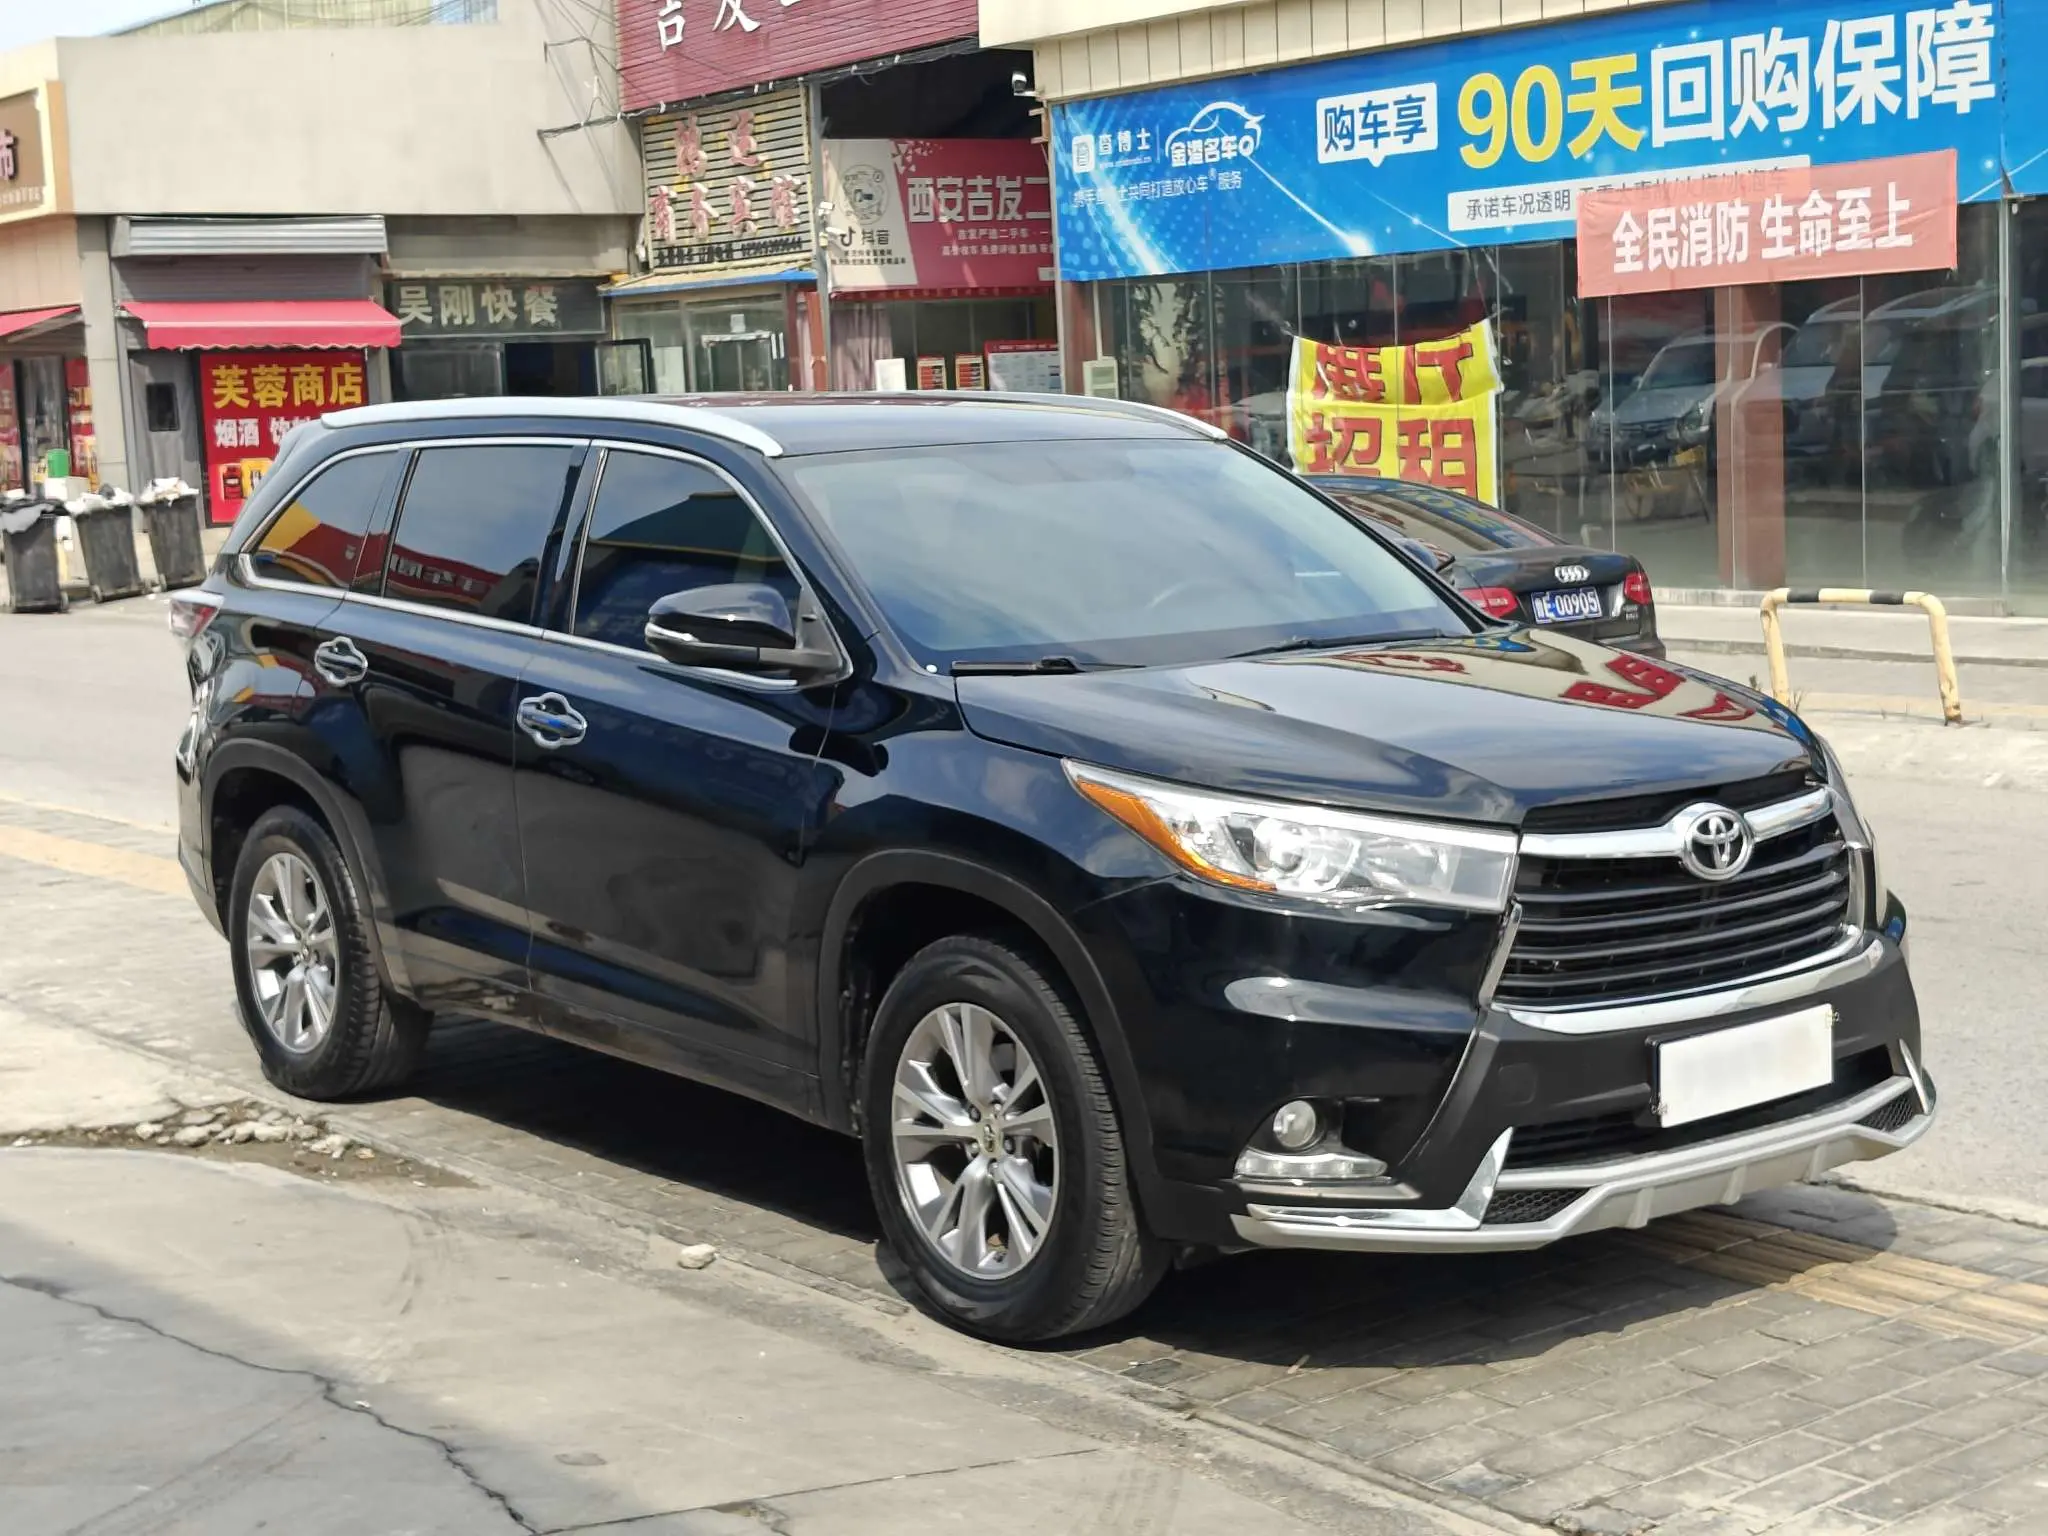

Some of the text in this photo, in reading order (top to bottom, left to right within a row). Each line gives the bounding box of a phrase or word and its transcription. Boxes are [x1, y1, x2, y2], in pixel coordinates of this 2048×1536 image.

[1458, 1, 1996, 168] 90天回购保障
[1323, 94, 1428, 154] 购车享
[906, 175, 1051, 223] 西安吉发二
[1465, 190, 1572, 221] 承诺车况透明
[1611, 182, 1913, 274] 全民消防 生命至上
[398, 284, 559, 327] 吴刚快餐
[211, 362, 364, 409] 芙蓉商店
[213, 417, 260, 449] 烟酒
[1304, 411, 1478, 500] 招租
